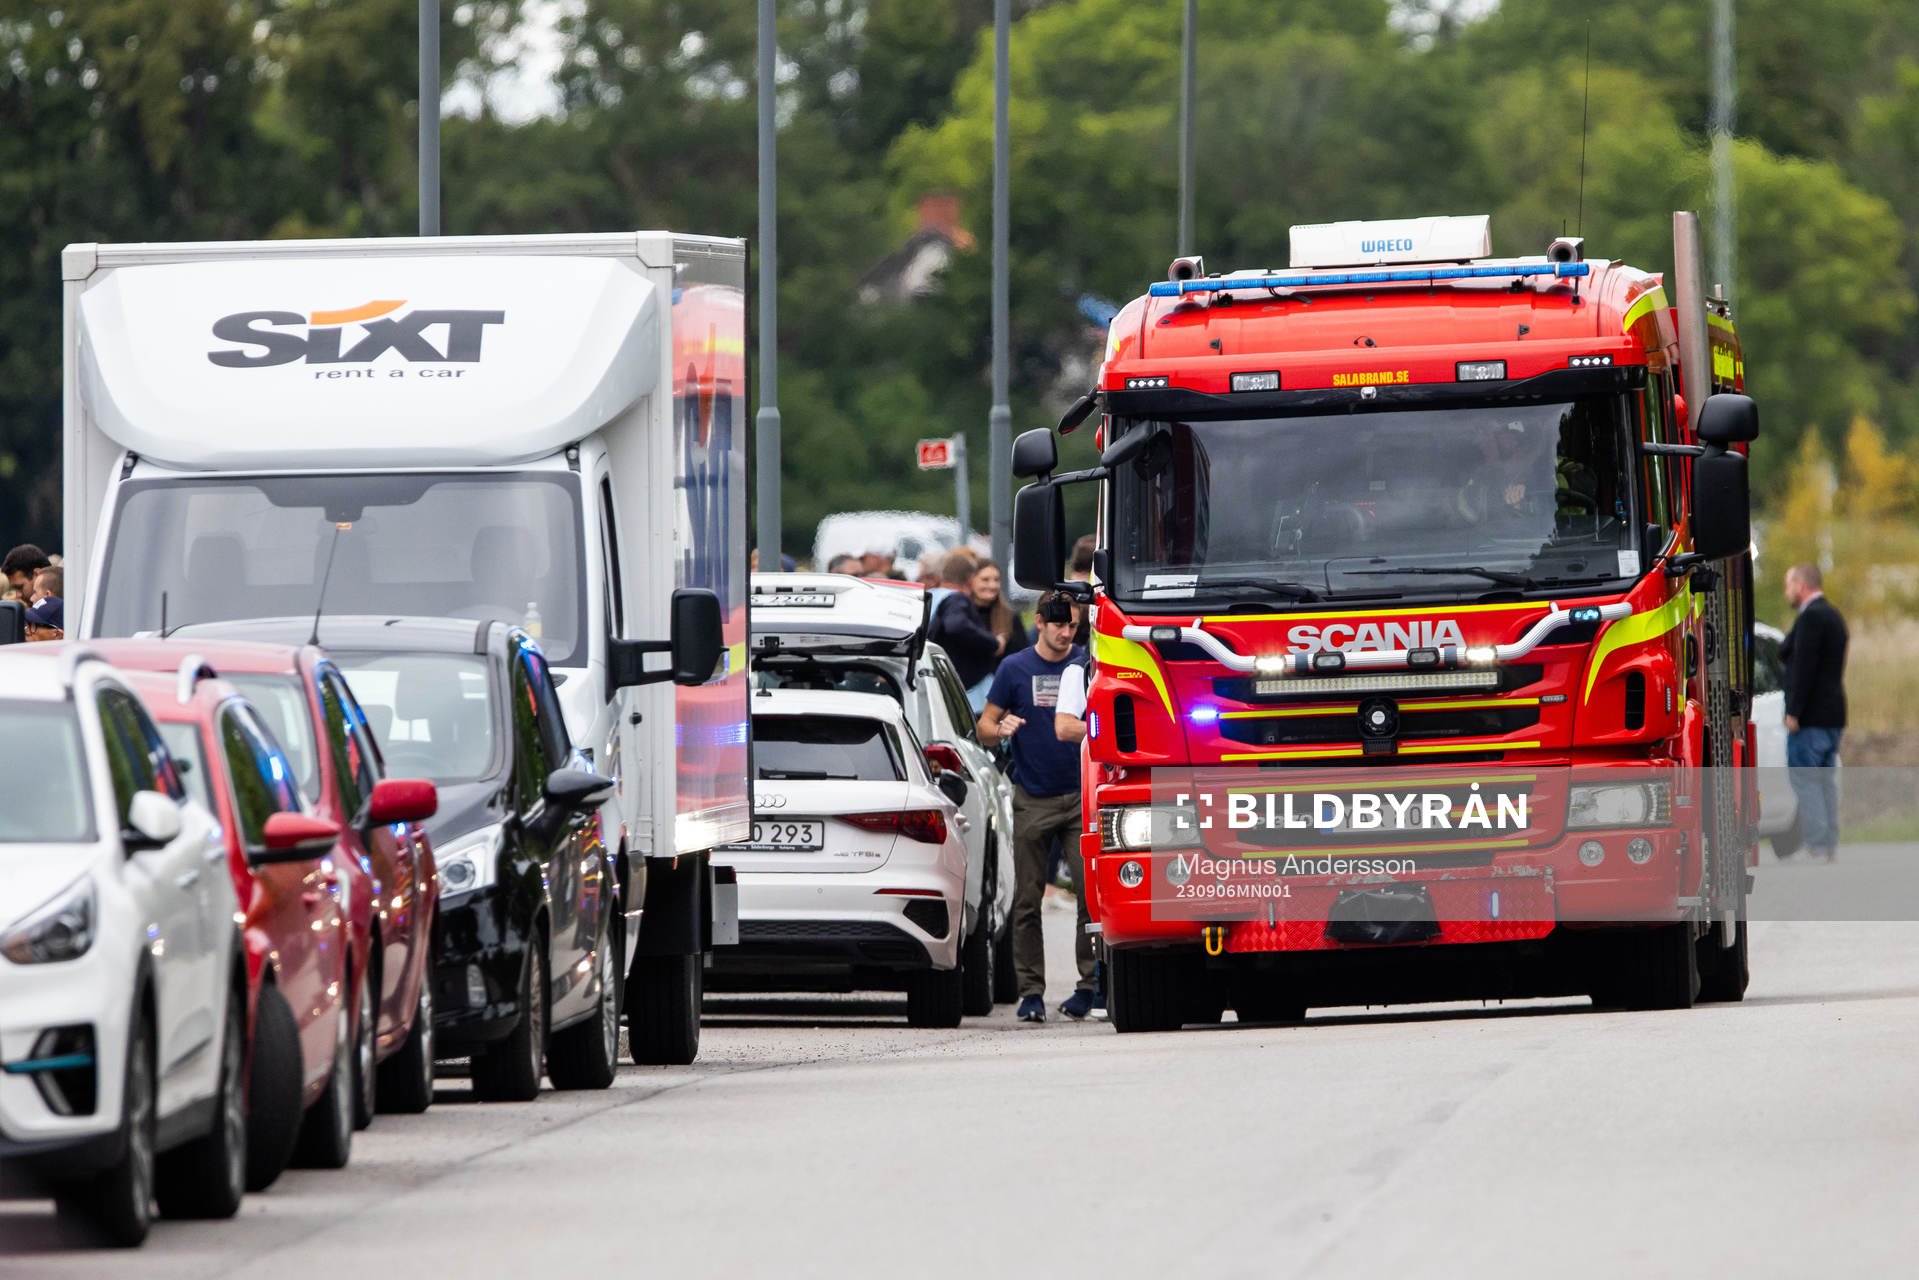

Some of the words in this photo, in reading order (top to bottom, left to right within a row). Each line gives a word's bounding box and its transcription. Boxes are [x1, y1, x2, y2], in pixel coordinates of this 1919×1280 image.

[1361, 239, 1412, 253] WAECO
[315, 368, 375, 380] rent
[389, 369, 404, 378] a
[419, 369, 466, 378] car
[1333, 370, 1409, 387] SALABRAND.SE
[1287, 619, 1467, 655] SCANIA
[771, 824, 813, 843] 293
